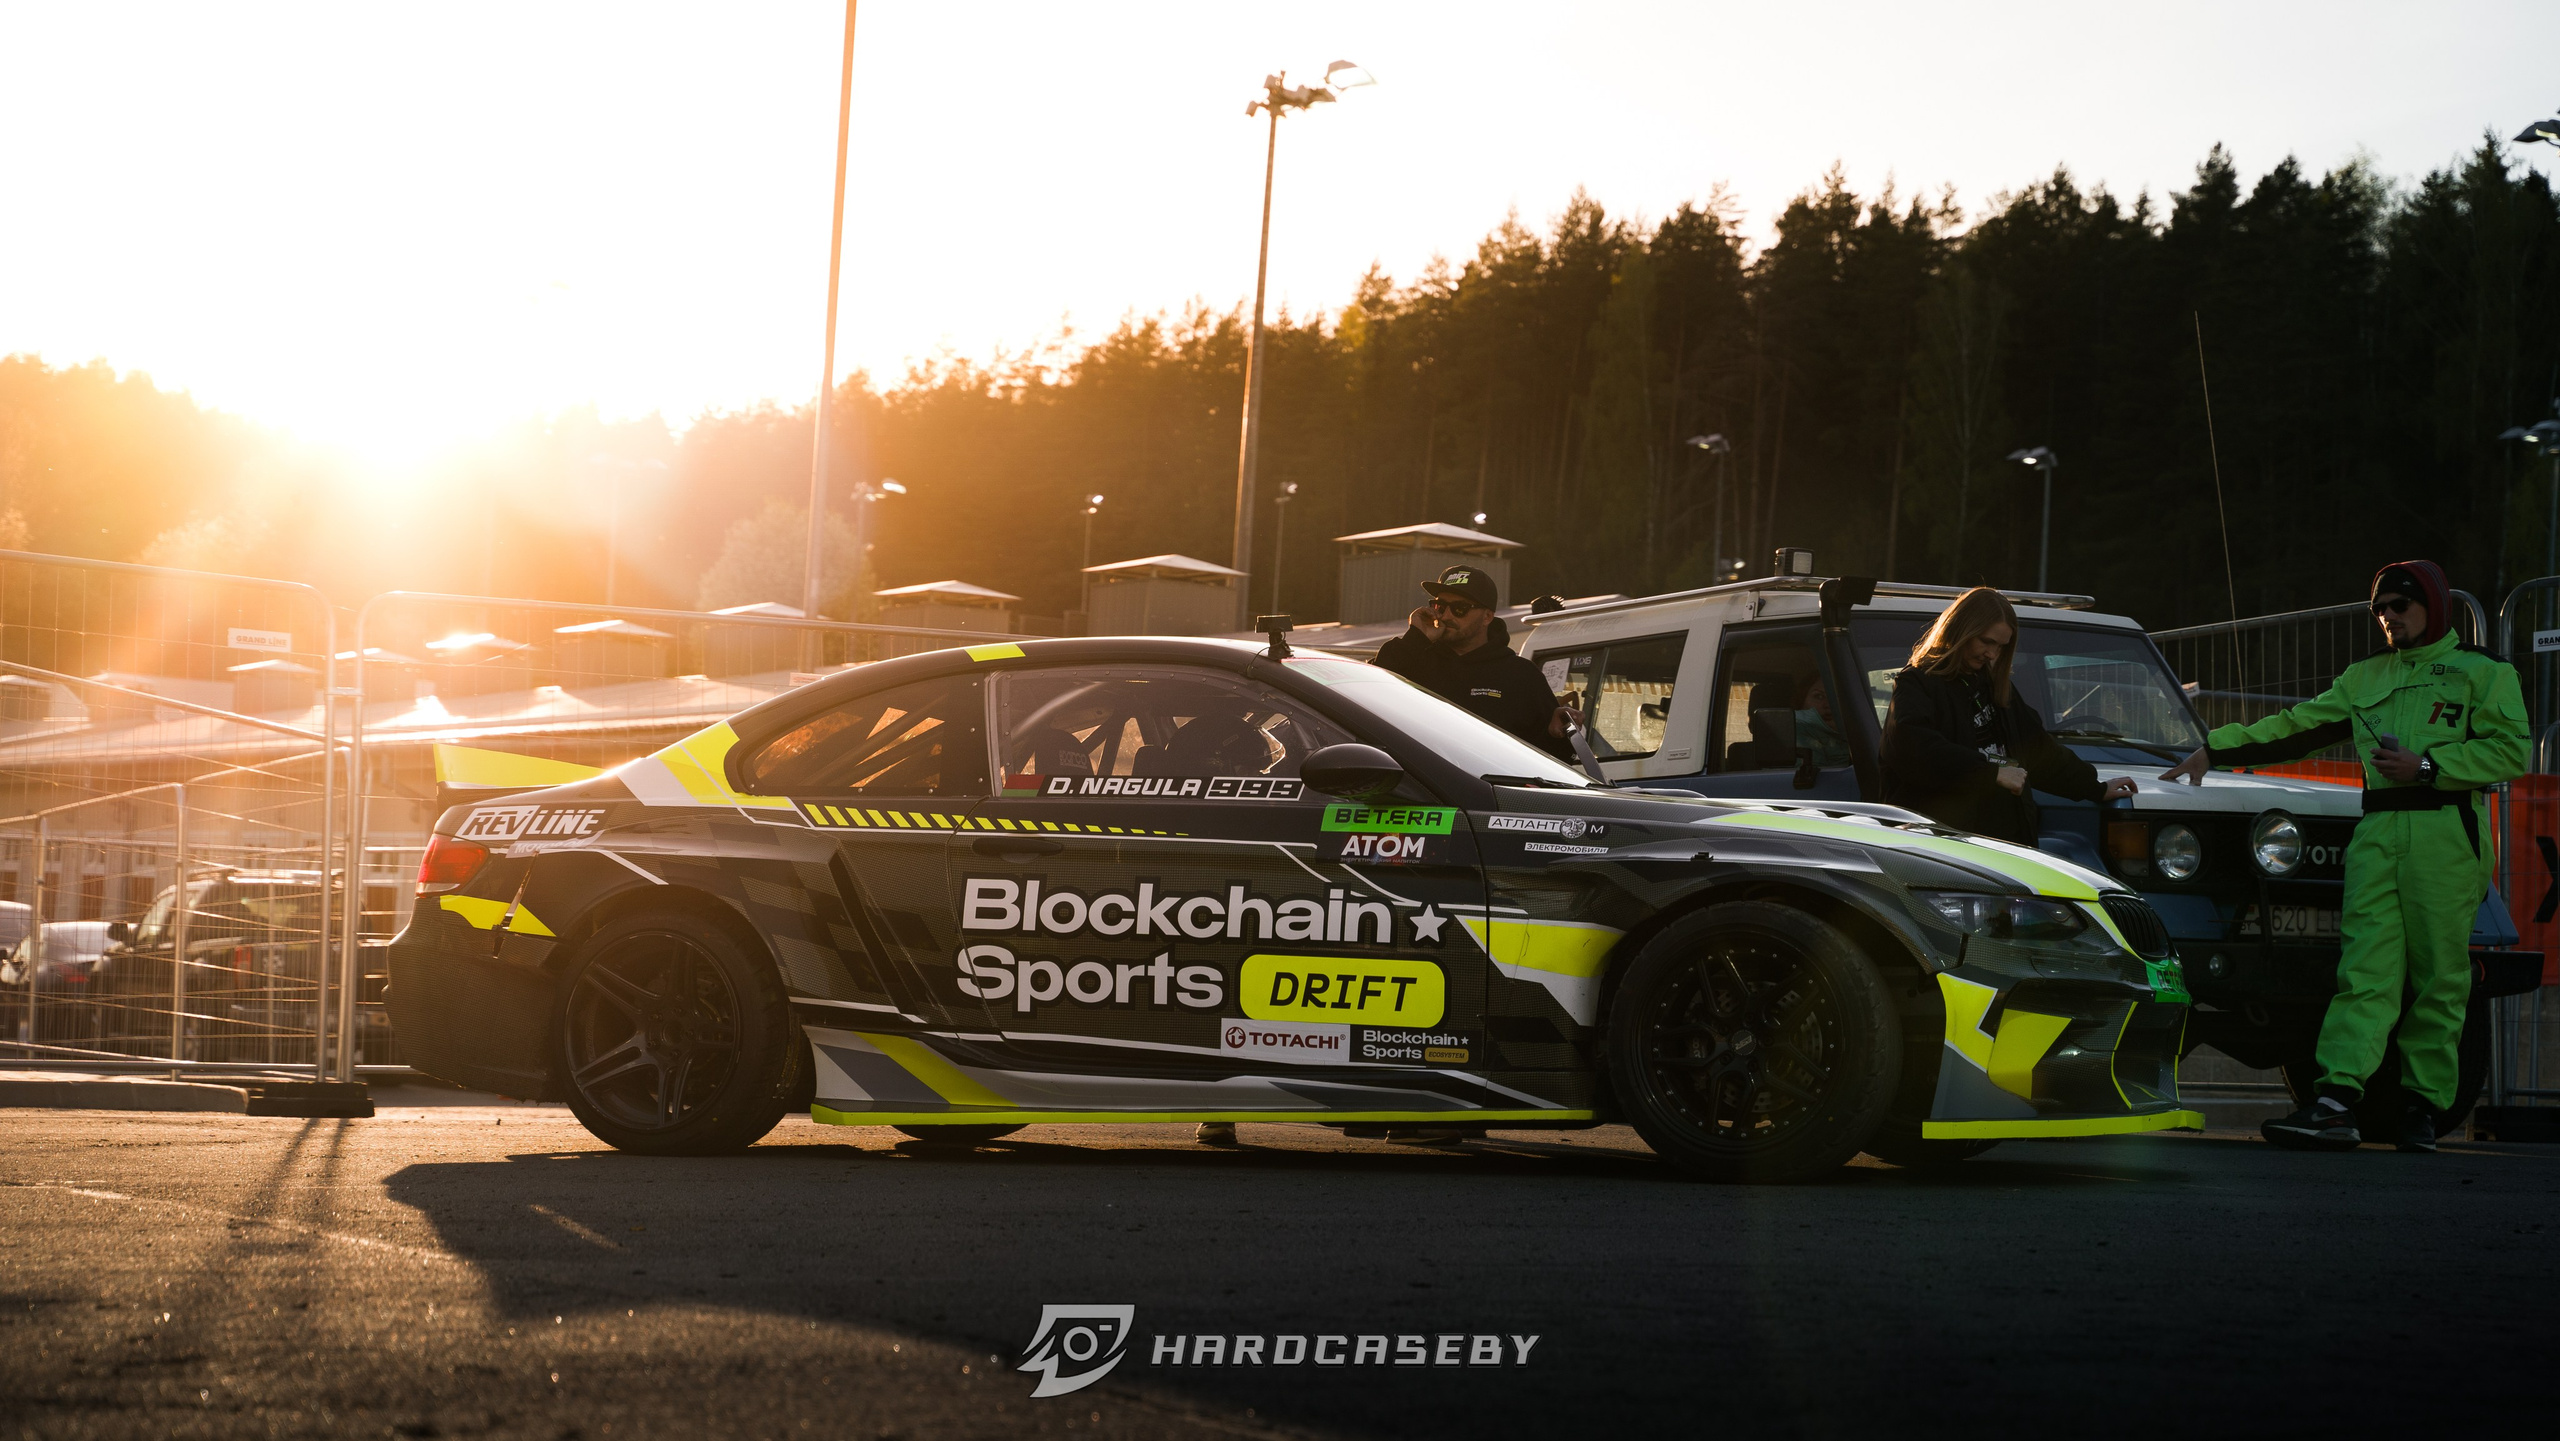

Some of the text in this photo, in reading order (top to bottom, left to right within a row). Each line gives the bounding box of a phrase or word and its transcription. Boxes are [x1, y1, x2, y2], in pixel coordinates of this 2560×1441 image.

[235, 635, 266, 644] GRAND
[1047, 778, 1303, 799] D. NAGULA 999
[1491, 817, 1560, 831] АТЛАНТ
[1526, 843, 1607, 853] ЭЛЕКТРОМОБИЛИ
[962, 878, 1392, 943] Blockchain
[957, 945, 1417, 1012] Sports DRIFT
[1362, 1029, 1458, 1046] Blockchain
[1362, 1044, 1466, 1060] Sports ECOSYSTEM
